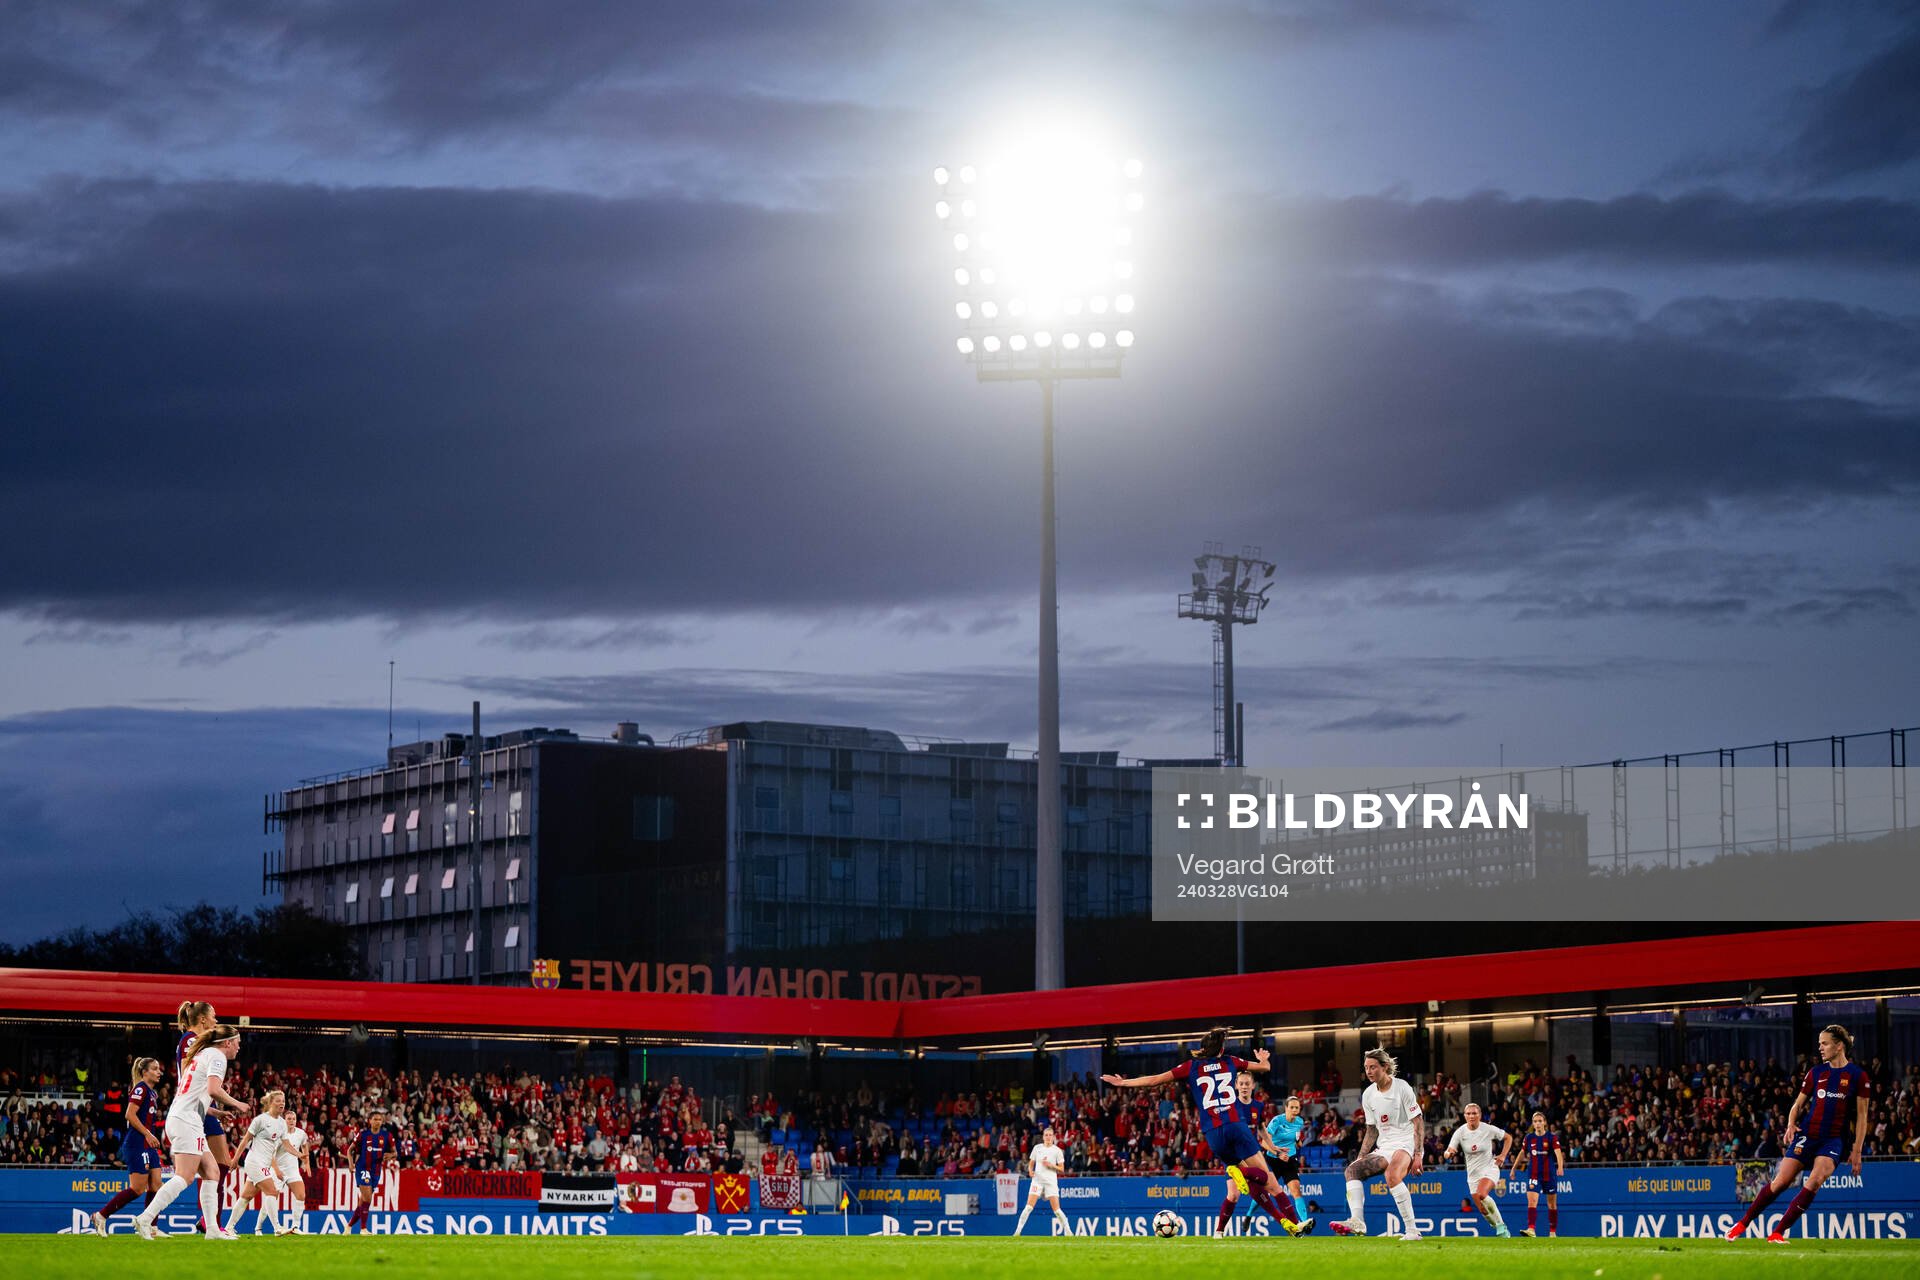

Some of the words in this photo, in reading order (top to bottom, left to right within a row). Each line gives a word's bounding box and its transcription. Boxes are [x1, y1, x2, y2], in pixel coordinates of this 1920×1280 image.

[1196, 1072, 1237, 1110] 23
[1826, 1091, 1846, 1100] Spotify
[1795, 1135, 1807, 1148] 2
[72, 1178, 97, 1192] MÉS
[99, 1181, 122, 1194] QUE
[443, 1174, 532, 1197] BORGERKRIG
[1060, 1187, 1100, 1198] BARCELONA
[1163, 1186, 1178, 1199] QUE
[1191, 1186, 1210, 1197] CLUB
[1421, 1182, 1443, 1195] CLUB
[1508, 1181, 1520, 1194] FC
[1628, 1176, 1648, 1192] MÉS
[1650, 1179, 1669, 1194] QUE
[1671, 1179, 1685, 1192] UN
[1686, 1179, 1711, 1192] CLUB
[547, 1192, 594, 1201] NYMARK
[372, 1214, 434, 1235] HAS
[446, 1214, 493, 1235] NO
[726, 1218, 804, 1236] PS5
[913, 1219, 965, 1236] PS5
[1106, 1216, 1148, 1237] HAS
[1602, 1213, 1666, 1238] PLAY
[1677, 1213, 1734, 1239] HAS
